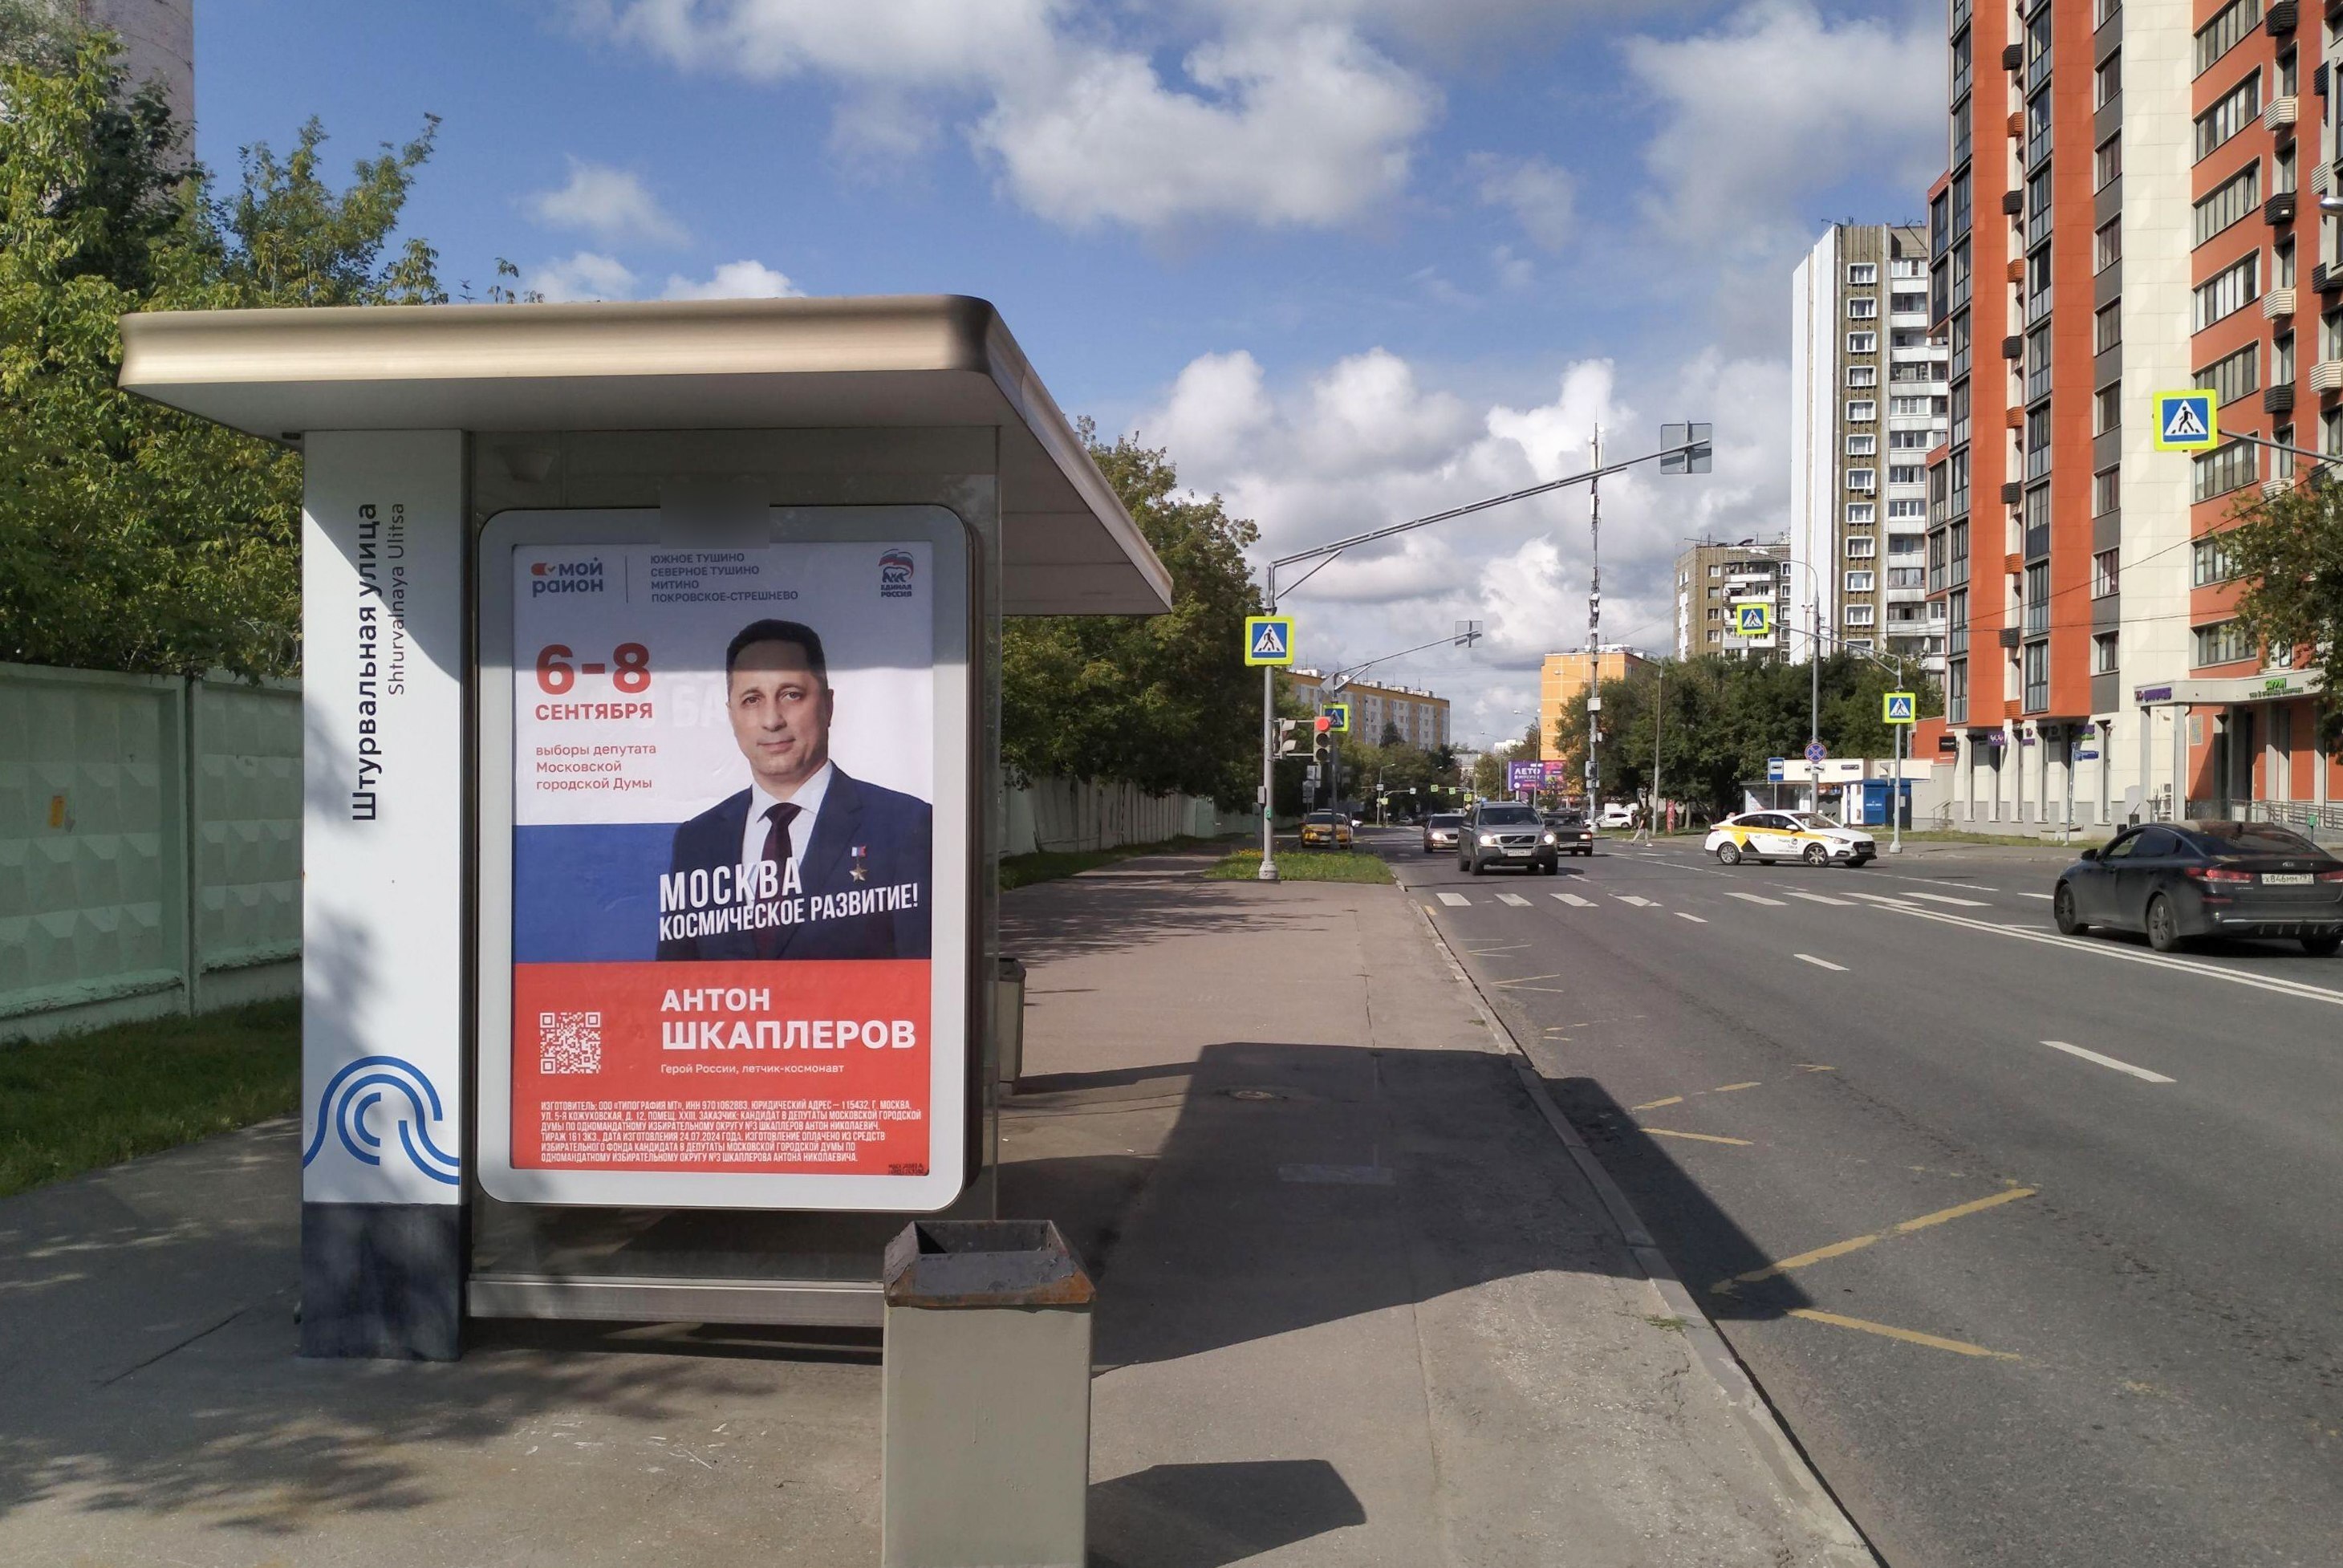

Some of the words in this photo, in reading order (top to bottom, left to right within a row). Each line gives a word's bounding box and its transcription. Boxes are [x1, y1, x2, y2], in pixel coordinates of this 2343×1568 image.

[387, 503, 404, 559] Ulitsa
[359, 503, 382, 598] улица
[650, 554, 693, 564] ЮЖНОЕ
[696, 553, 745, 563] ТУШИНО
[651, 567, 709, 577] СЕВЕРНОЕ
[710, 566, 760, 575] ТУШИНО
[651, 579, 700, 590] МИТИНО
[652, 591, 798, 603] ПОКРОВСКОЕ-СТРЕШНЕВО
[388, 566, 408, 696] Shturvalnaya
[352, 606, 382, 821] Штурвальная
[535, 702, 653, 721] СЕНТЯБРЯ
[536, 745, 590, 758] выборы
[593, 743, 656, 758] депутата
[536, 760, 622, 773] Московской
[536, 778, 610, 791] городской
[613, 778, 652, 790] Думы
[660, 856, 802, 912] МОСКВА
[660, 898, 805, 942] КОСМИЧЕСКОЕ
[810, 883, 919, 921] РАЗВИТИЕ!
[660, 988, 770, 1012] АНТОН
[662, 1020, 916, 1050] ШКАПЛЕРОВ
[660, 1062, 692, 1075] Герой
[696, 1063, 739, 1074] России,
[741, 1063, 845, 1074] летчик-космонавт
[599, 1101, 612, 1111] ООО
[686, 1101, 700, 1111] ИНН
[752, 1099, 806, 1111] ЮРИДИЧЕСКИЙ
[808, 1100, 831, 1111] АДРЕС
[555, 1111, 566, 1120] 5-Я
[741, 1111, 779, 1120] КАНДИДАТ
[782, 1111, 787, 1119] В
[788, 1111, 827, 1120] ДЕПУТАТЫ
[829, 1109, 877, 1119] МОСКОВСКОЙ
[879, 1109, 921, 1120] ГОРОДСКОЙ
[541, 1122, 564, 1131] ДУМЫ
[566, 1122, 575, 1131] ПО
[577, 1122, 646, 1131] ОДНОМАНДАТНОМУ
[648, 1122, 714, 1131] ИЗБИРАТЕЛЬНОМУ
[716, 1121, 743, 1130] ОКРУГУ
[759, 1121, 802, 1130] ШКАПЛЕРОВ
[805, 1121, 828, 1130] АНТОН
[541, 1132, 566, 1141] ТИРАЖ
[569, 1132, 581, 1141] 161
[603, 1132, 621, 1142] ДАТА
[623, 1132, 678, 1141] ИЗГОТОВЛЕНИЯ
[680, 1132, 720, 1141] 24.07.2024
[745, 1131, 800, 1140] ИЗГОТОВЛЕНИЕ
[802, 1131, 840, 1140] ОПЛАЧЕНО
[842, 1131, 851, 1140] ИЗ
[853, 1131, 885, 1141] СРЕДСТВ
[542, 1143, 605, 1152] ИЗБИРАТЕЛЬНОГО
[607, 1143, 633, 1152] ФОНДА
[635, 1143, 678, 1152] КАНДИДАТА
[680, 1143, 685, 1152] В
[686, 1142, 725, 1152] ДЕПУТАТЫ
[727, 1140, 774, 1151] МОСКОВСКОЙ
[777, 1140, 818, 1152] ГОРОДСКОЙ
[820, 1142, 844, 1152] ДУМЫ
[846, 1142, 855, 1151] ПО
[542, 1153, 611, 1163] ОДНОМАНДАТНОМУ
[612, 1153, 678, 1162] ИЗБИРАТЕЛЬНОМУ
[680, 1153, 707, 1162] ОКРУГУ
[723, 1152, 771, 1161] ШКАПЛЕРОВА
[774, 1152, 802, 1161] АНТОНА
